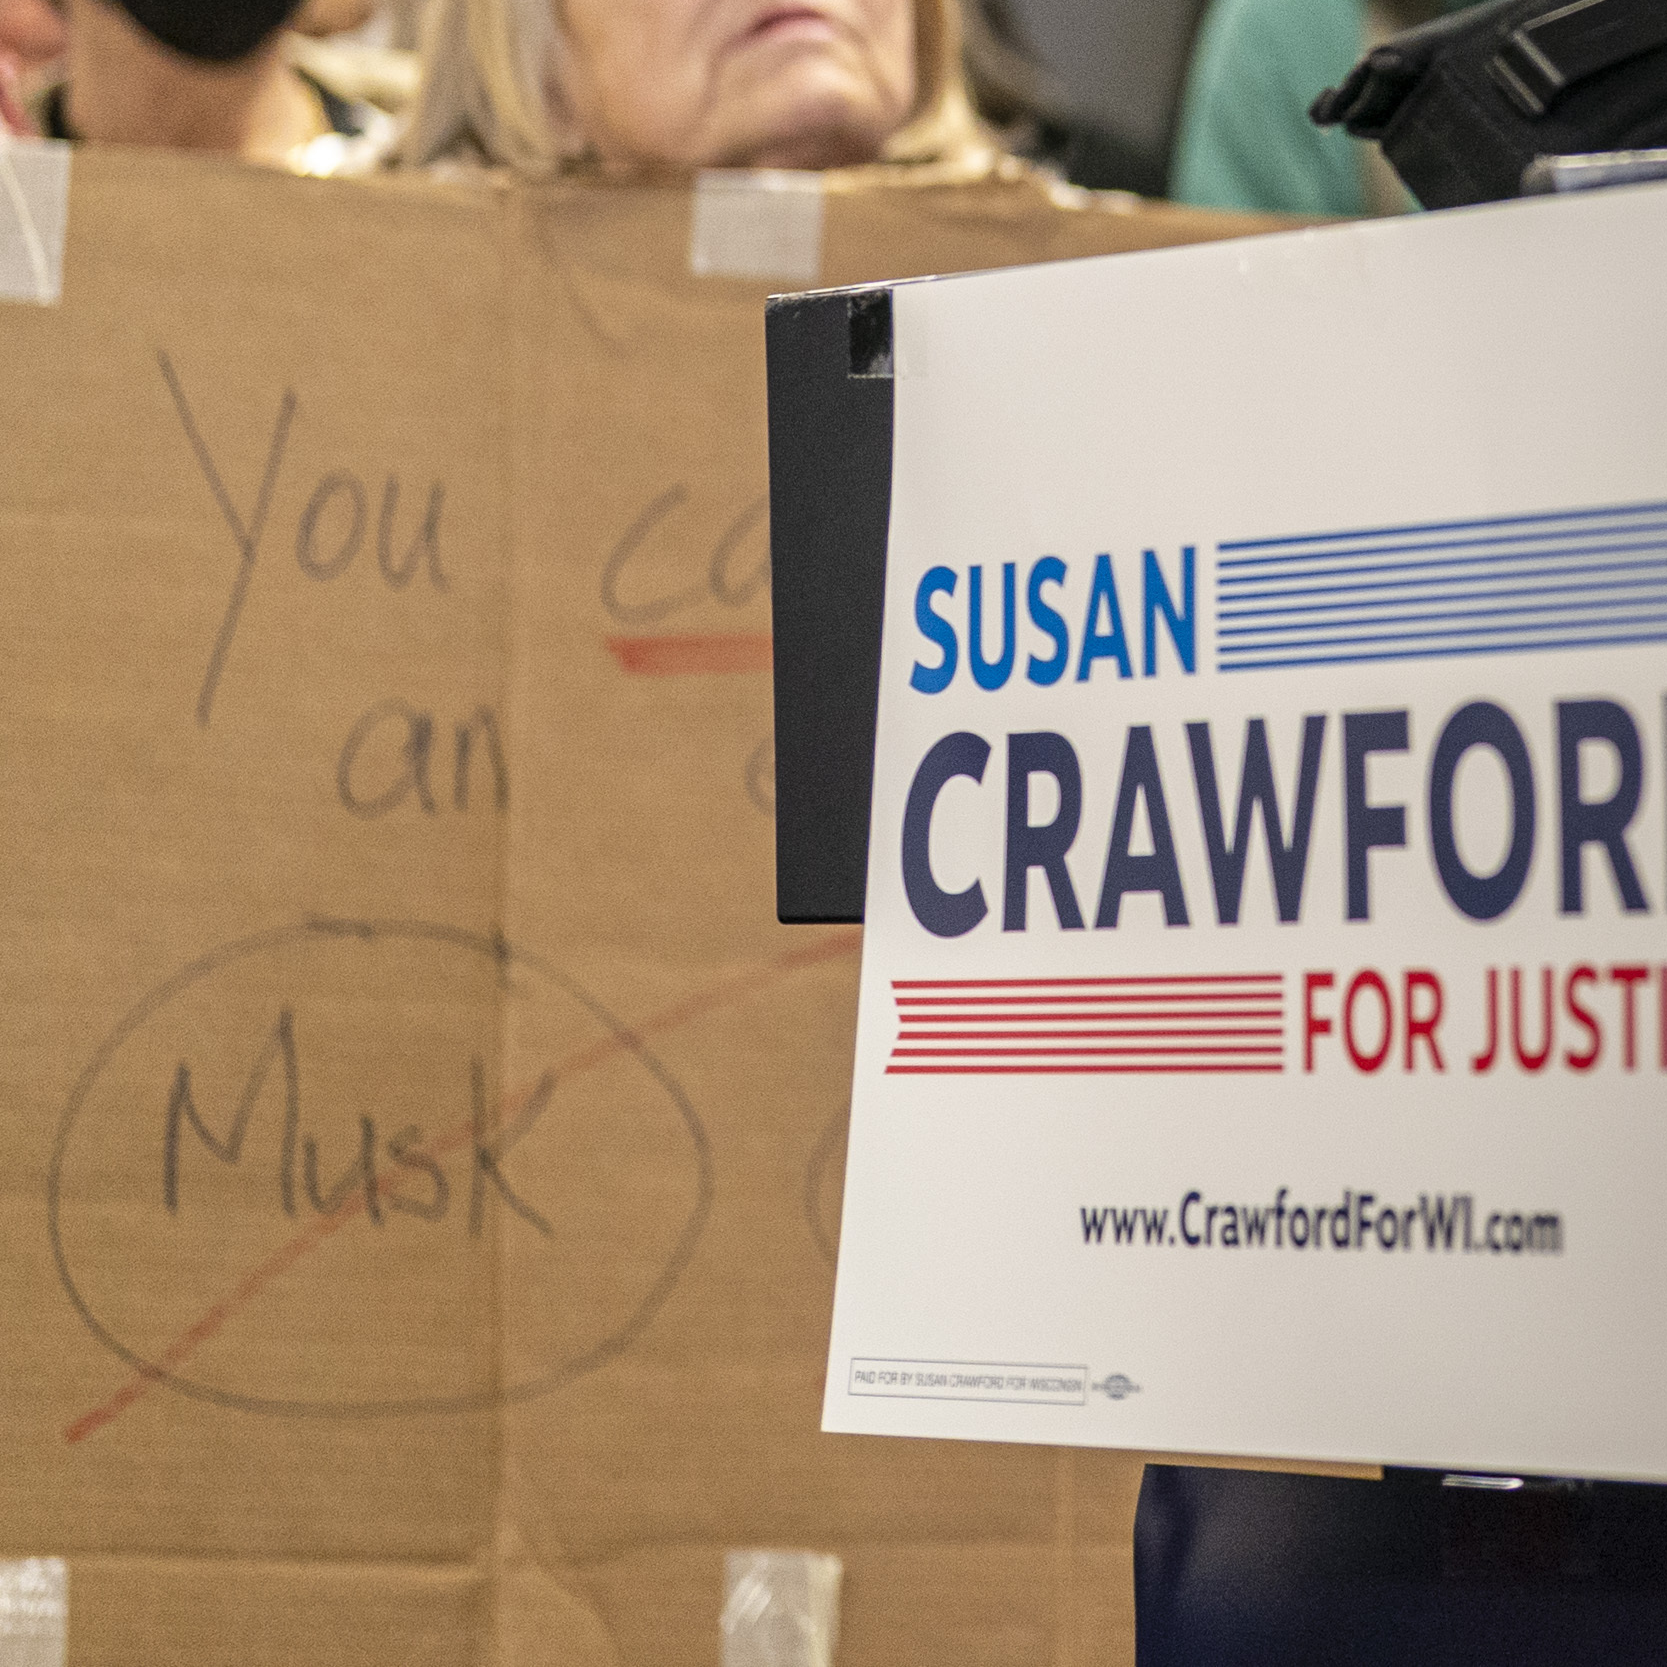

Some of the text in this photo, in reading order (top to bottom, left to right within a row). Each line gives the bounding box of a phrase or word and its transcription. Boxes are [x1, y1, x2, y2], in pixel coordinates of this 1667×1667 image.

[158, 349, 452, 729] You
[908, 544, 1199, 695] SUSAN
[1302, 969, 1446, 1074] FOR
[1079, 1187, 1567, 1255] www.CrawfordForWI.com
[855, 1371, 875, 1384] PAID
[878, 1372, 898, 1385] FOR
[901, 1373, 913, 1385] BY
[915, 1373, 947, 1387] SUSAN
[950, 1375, 1004, 1390] CRAWFORD
